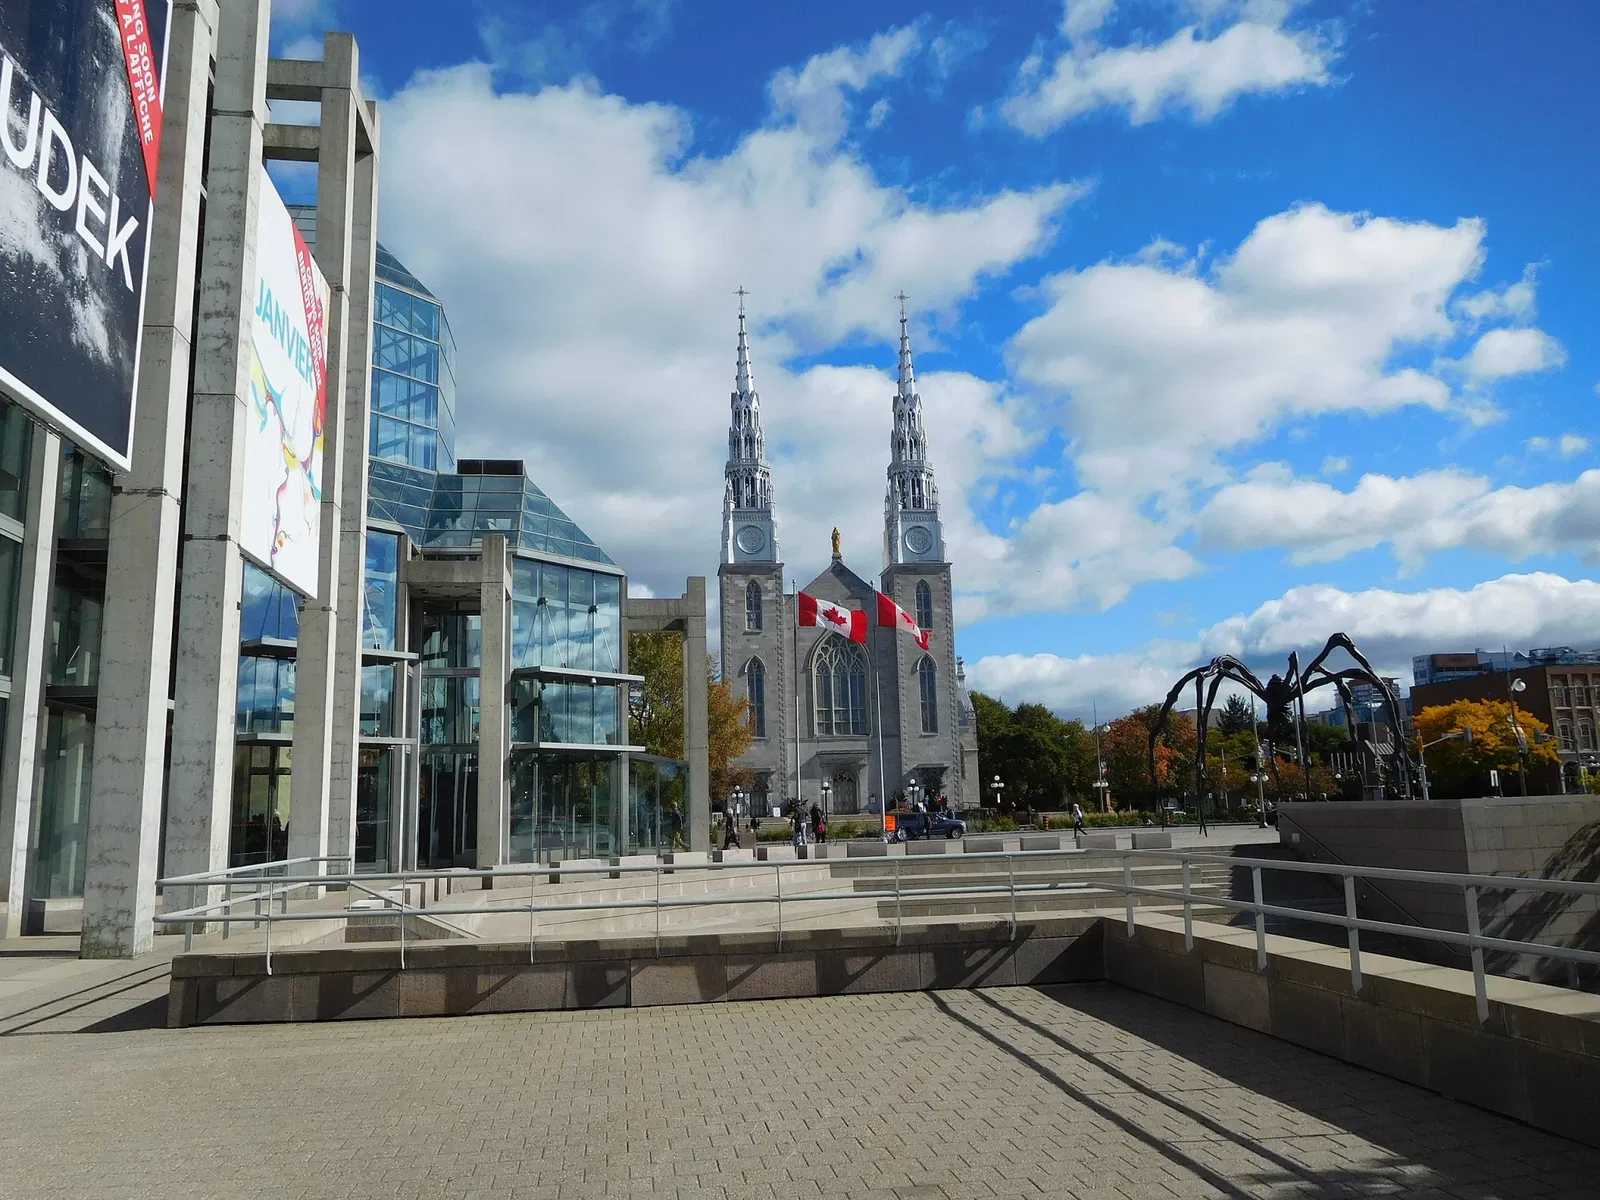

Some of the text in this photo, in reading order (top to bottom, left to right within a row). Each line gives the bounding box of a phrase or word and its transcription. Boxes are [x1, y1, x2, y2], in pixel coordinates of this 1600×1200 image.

[127, 34, 154, 145] L'AFFICHE
[131, 0, 156, 102] NG SOON
[0, 55, 139, 293] UDEK
[256, 277, 313, 391] JANVIER
[306, 266, 323, 361] COMING SOON
